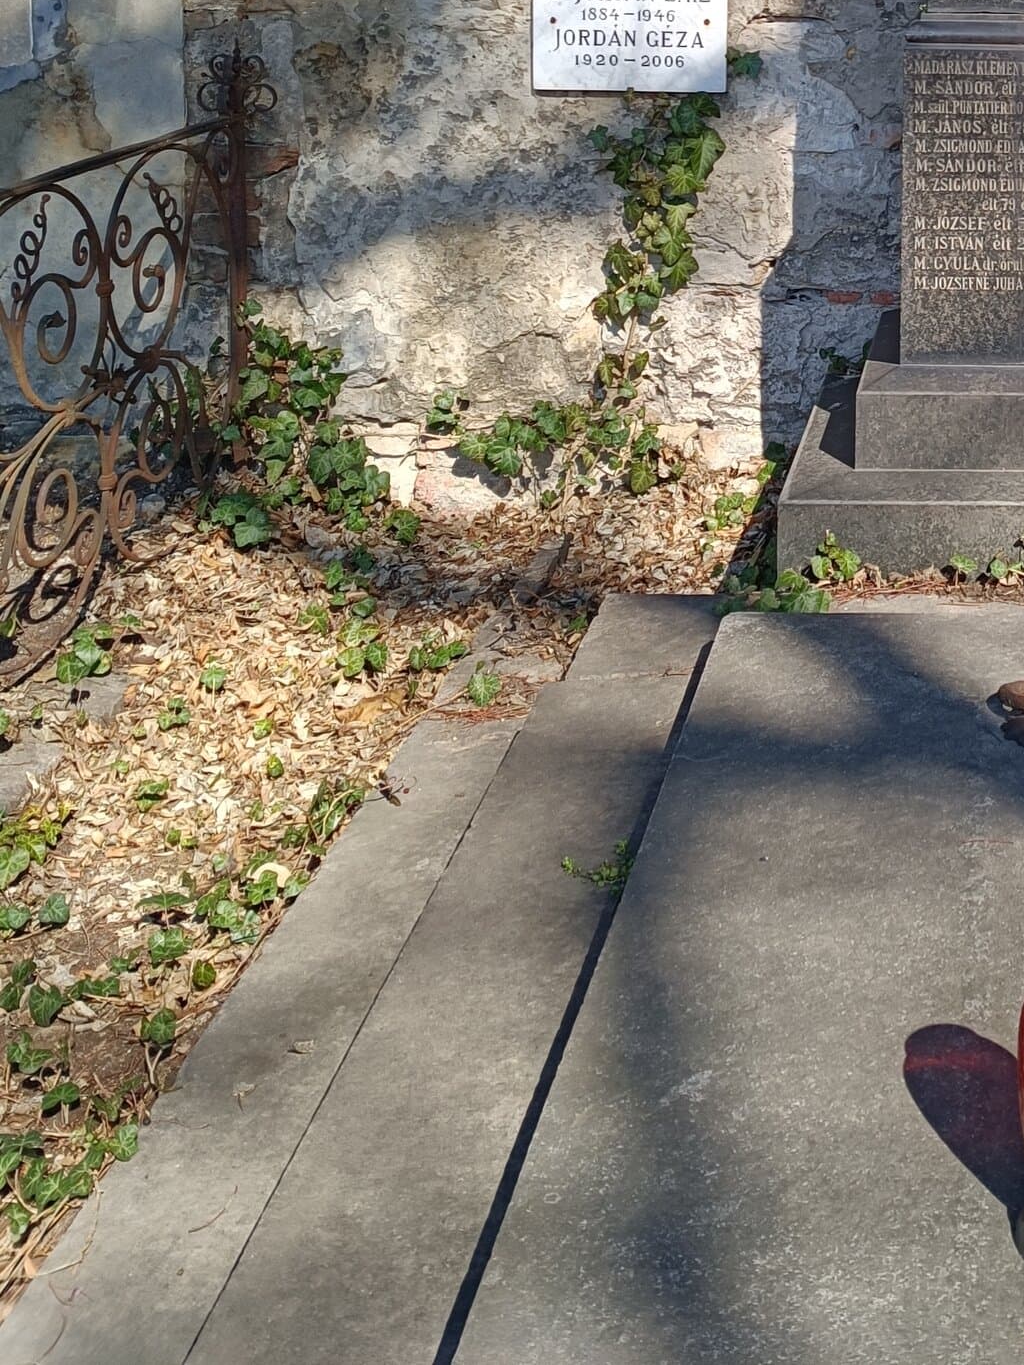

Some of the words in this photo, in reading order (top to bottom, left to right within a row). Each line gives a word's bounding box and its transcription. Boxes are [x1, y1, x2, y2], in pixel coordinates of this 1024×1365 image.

[553, 24, 637, 52] JORDÁN
[646, 25, 704, 48] GÉZA
[914, 80, 931, 95] M.
[914, 120, 931, 134] M.
[915, 138, 931, 153] M.
[916, 158, 932, 173] M.
[915, 177, 930, 192] M.
[914, 216, 930, 231] M.
[914, 235, 930, 250] M.
[935, 231, 984, 250] ISTVÁN
[914, 256, 930, 270] M.
[914, 275, 930, 291] M.
